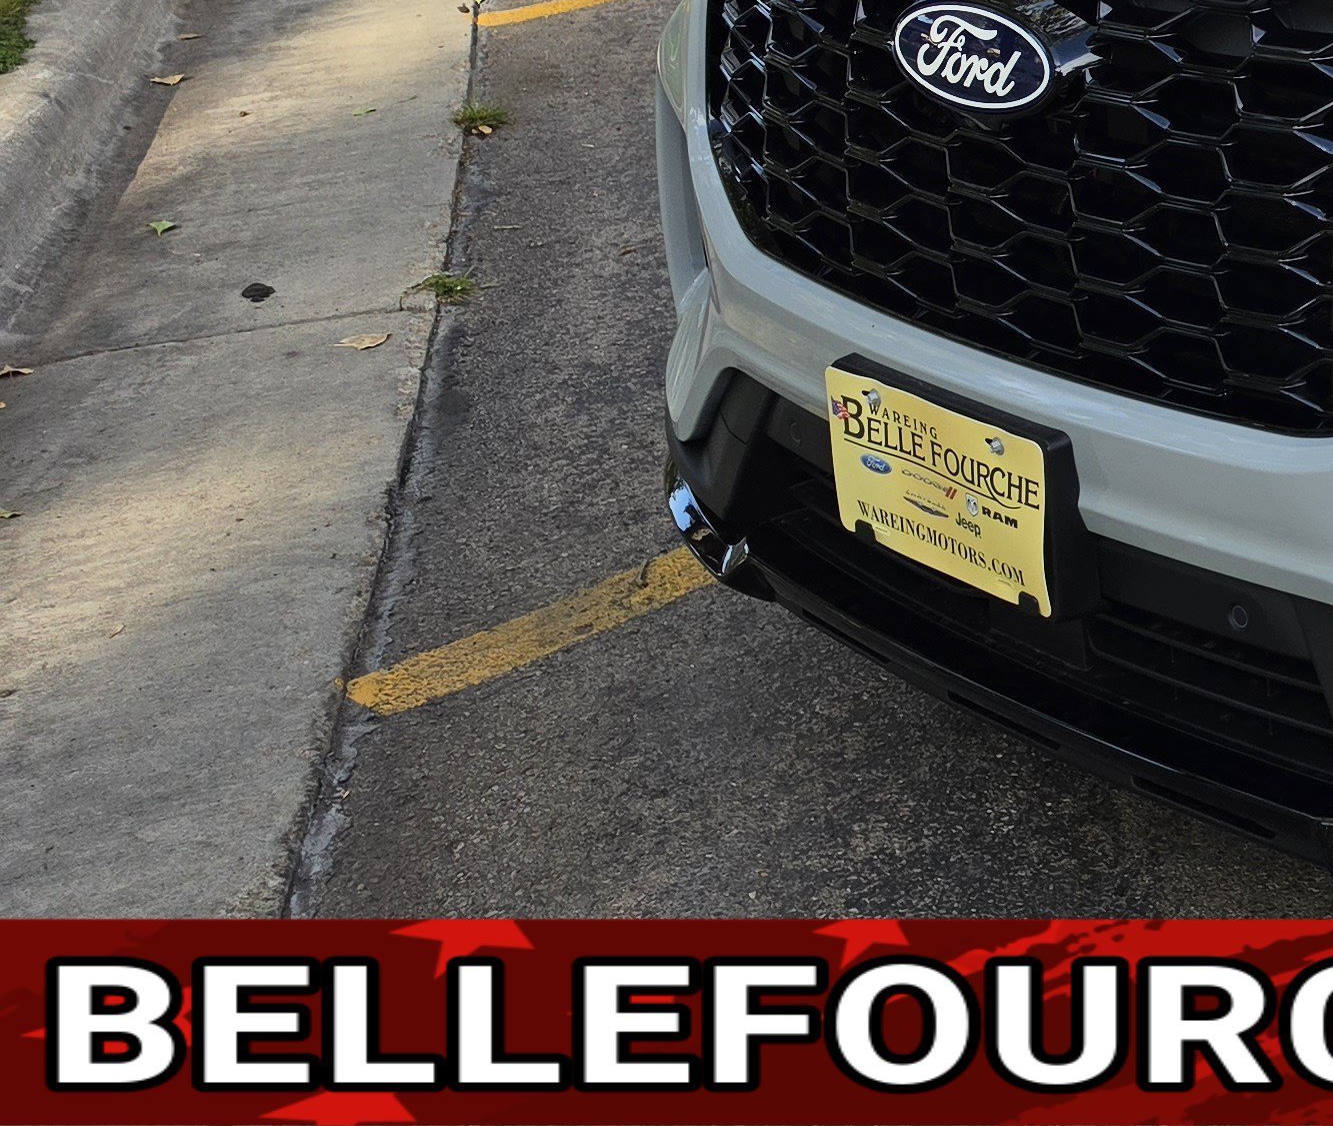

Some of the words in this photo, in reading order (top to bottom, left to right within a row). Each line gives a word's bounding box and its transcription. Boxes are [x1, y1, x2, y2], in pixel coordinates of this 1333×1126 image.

[916, 14, 1021, 98] Ford
[869, 404, 938, 440] WAREING
[841, 395, 926, 462] BELLE
[930, 440, 1040, 511] FOURCHE
[857, 499, 1025, 587] WAREINGMOTORS.COM
[955, 512, 981, 538] Jeep
[982, 506, 1018, 529] RAM
